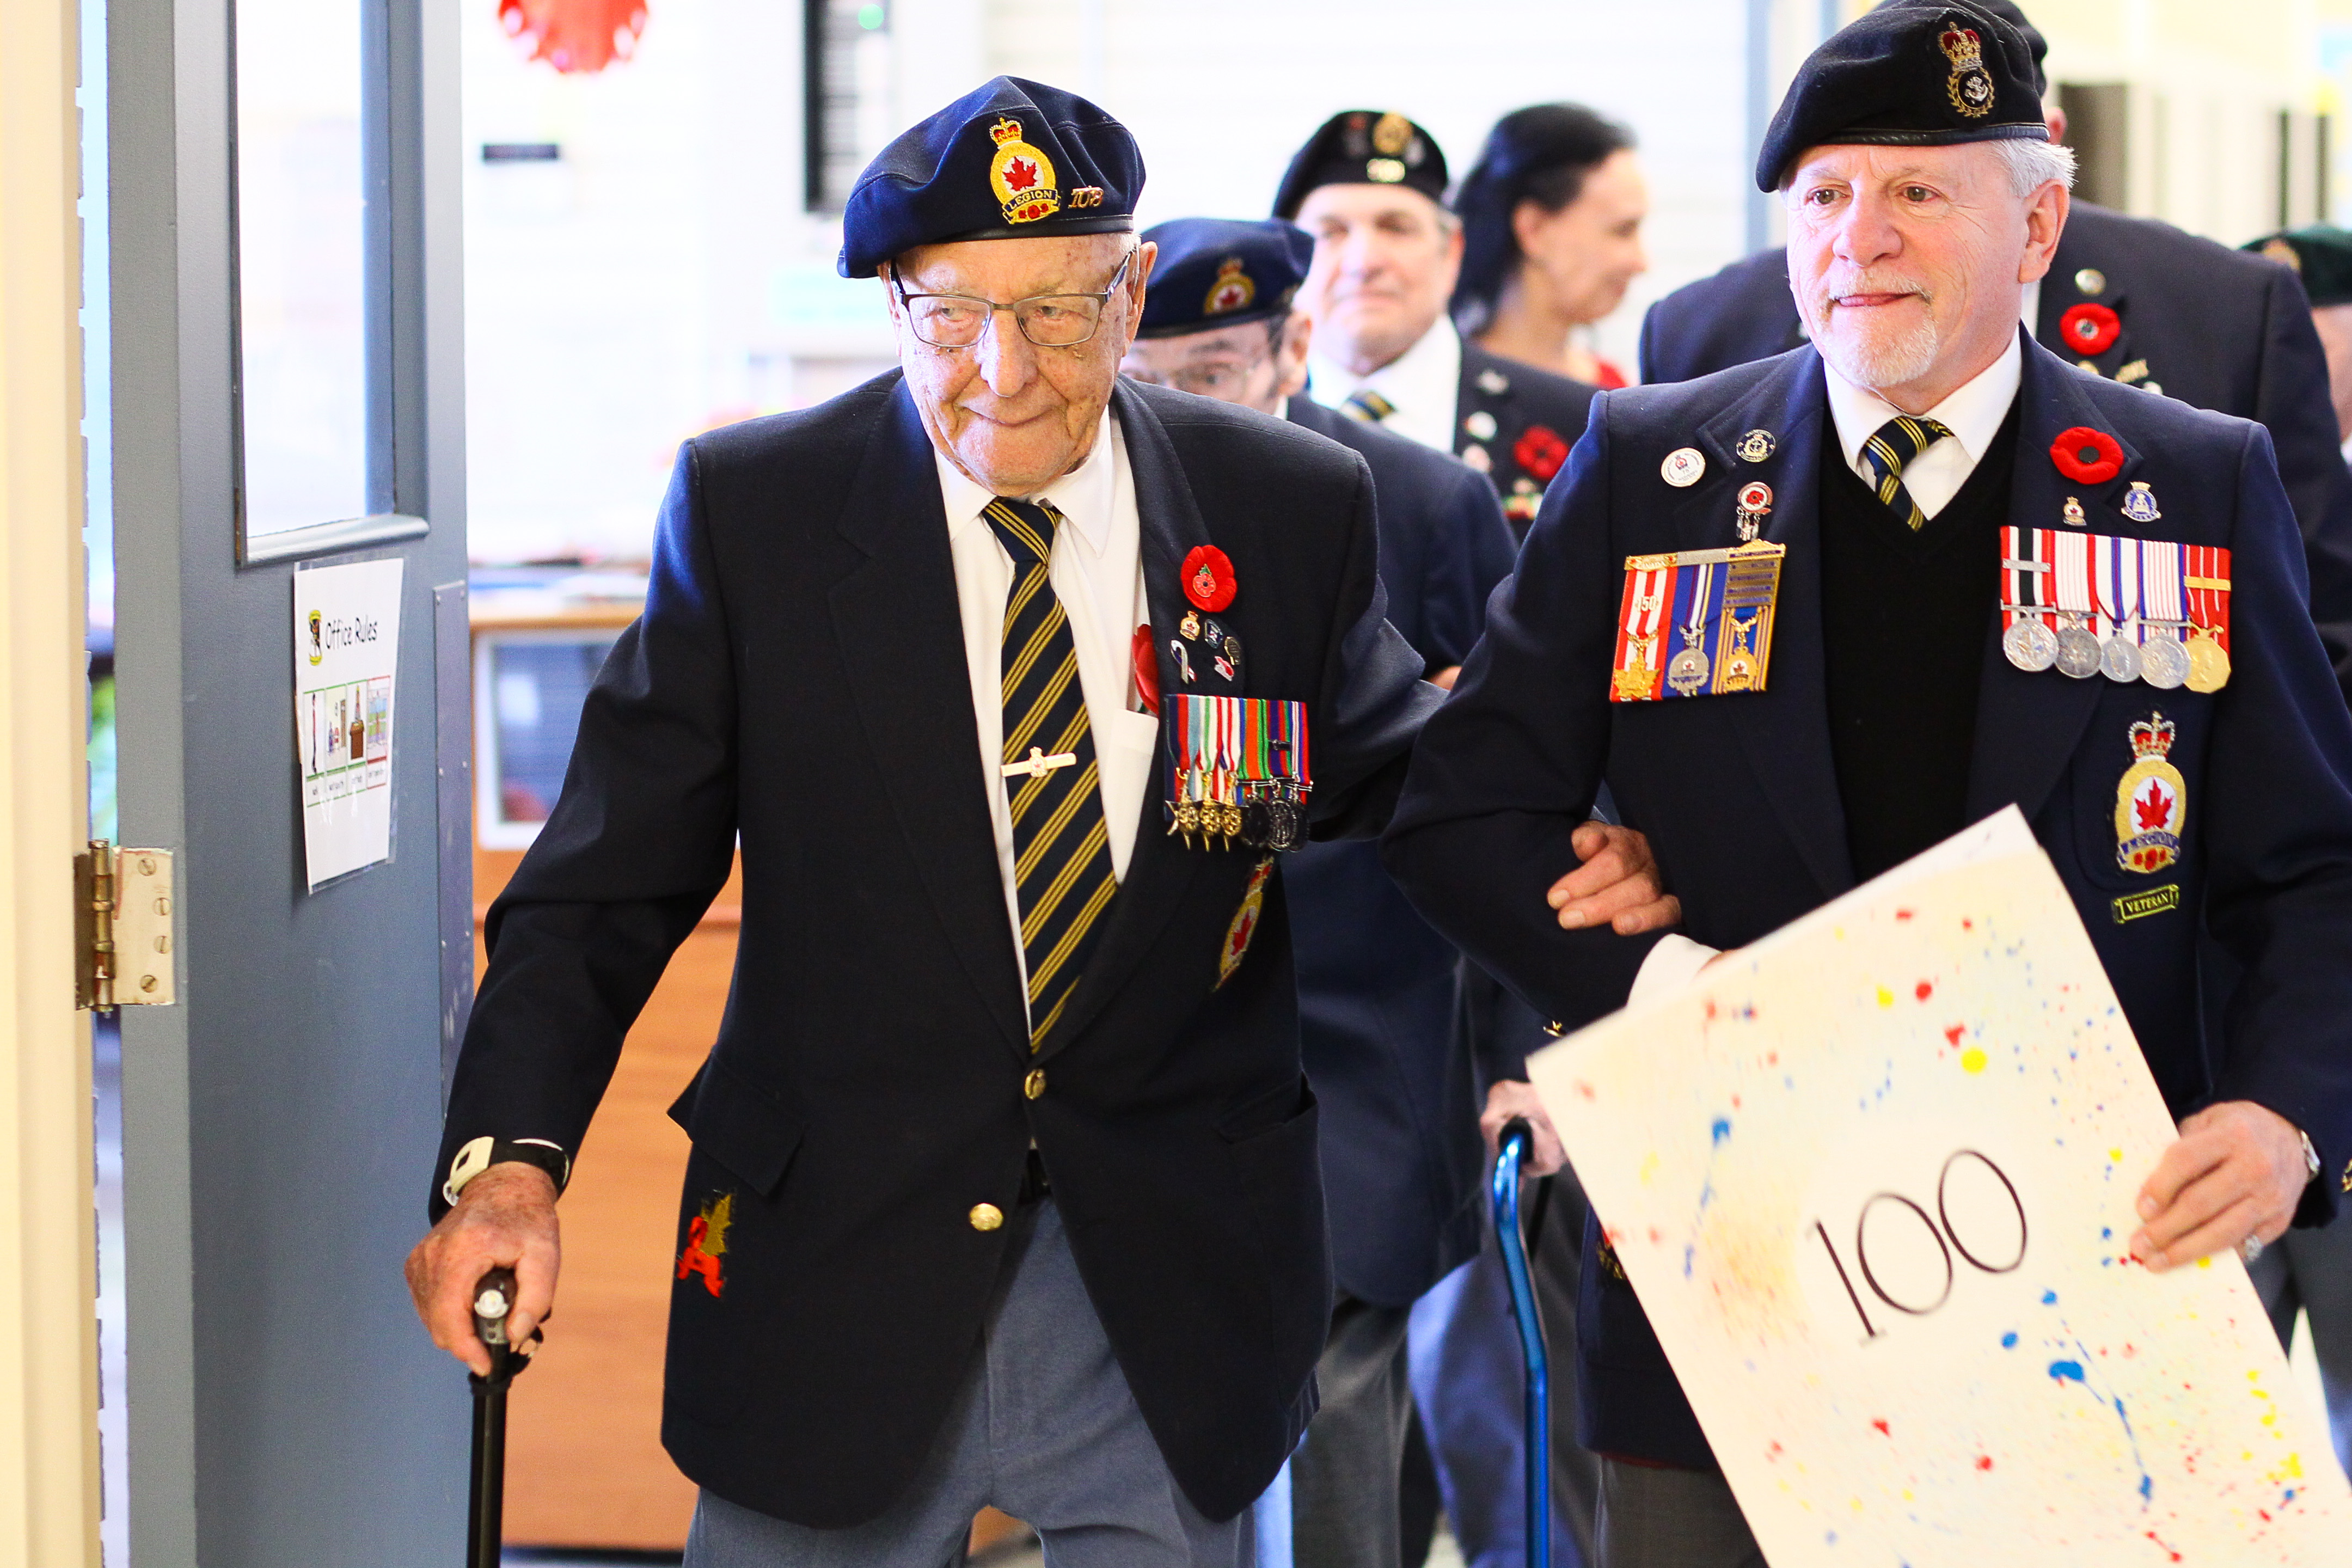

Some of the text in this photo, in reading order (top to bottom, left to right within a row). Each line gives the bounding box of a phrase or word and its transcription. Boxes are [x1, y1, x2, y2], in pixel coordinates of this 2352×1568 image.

[1008, 191, 1052, 210] LEGION
[1637, 596, 1656, 611] 150
[326, 614, 377, 650] Office Rules
[2126, 892, 2169, 913] VETERAN
[1805, 1148, 2027, 1347] 100
